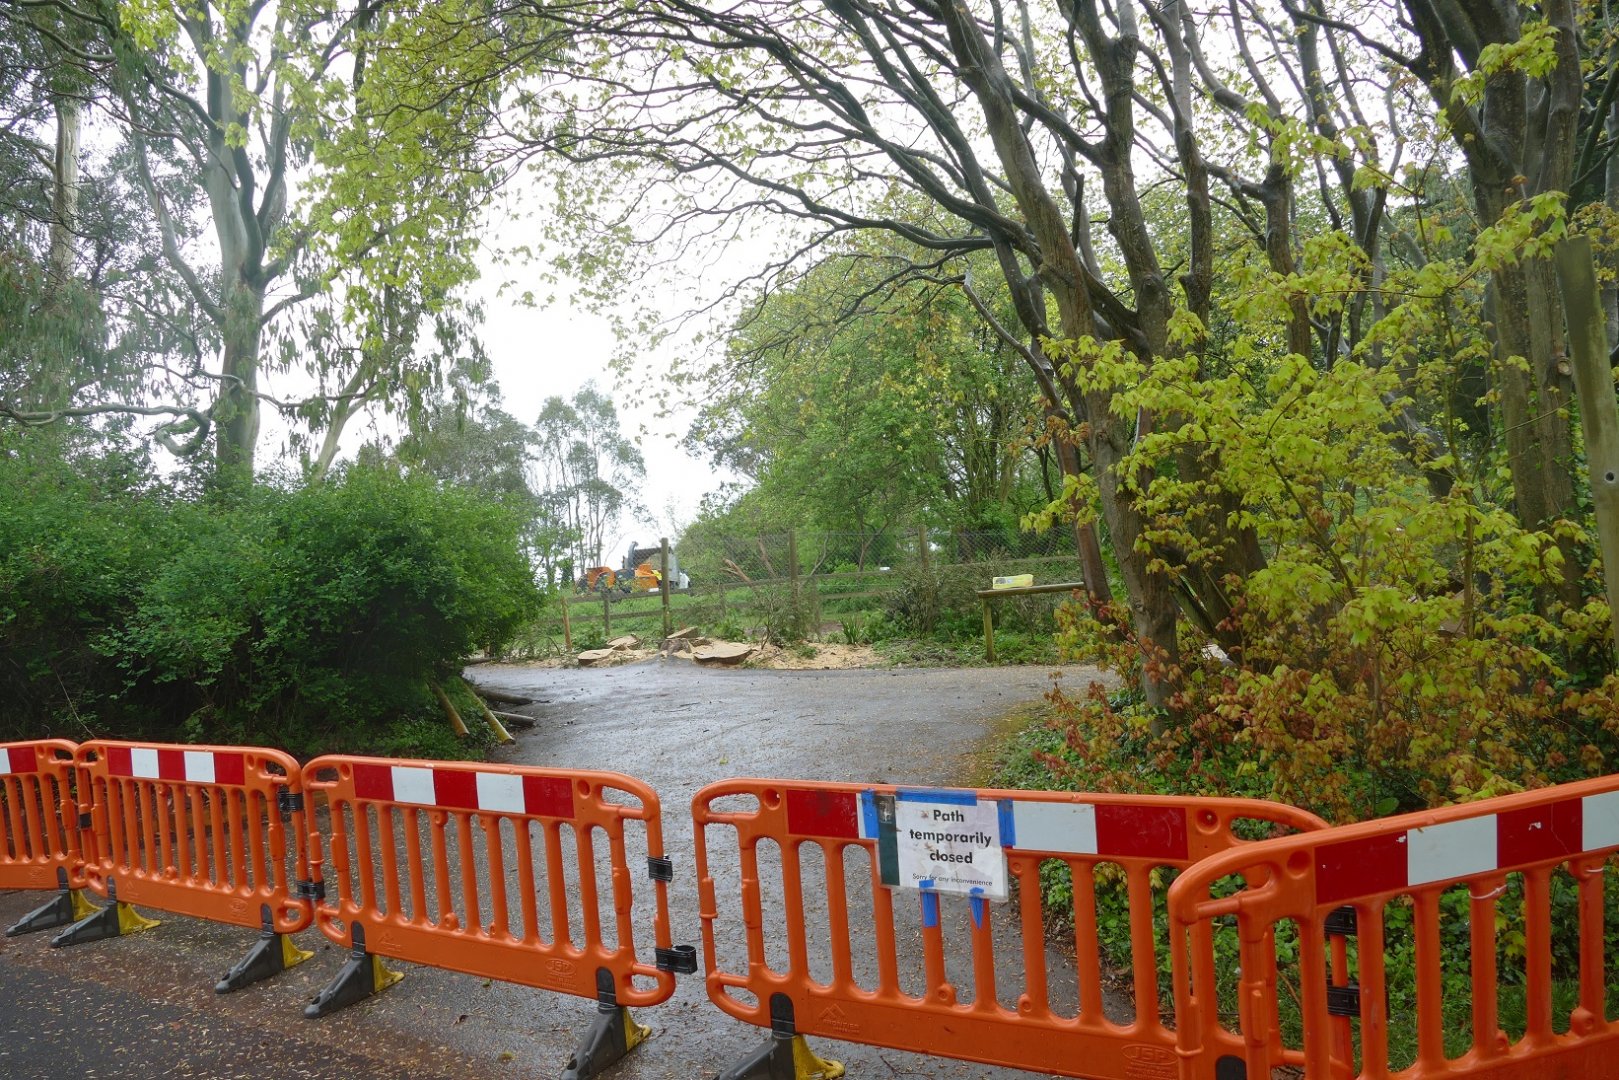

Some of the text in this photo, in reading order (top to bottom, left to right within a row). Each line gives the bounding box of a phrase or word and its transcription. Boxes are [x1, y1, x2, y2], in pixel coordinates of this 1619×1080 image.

[933, 809, 965, 822] Path
[909, 828, 992, 848] temporarily
[929, 849, 973, 864] closed
[912, 873, 928, 881] Sorry
[950, 876, 993, 887] inconvenience
